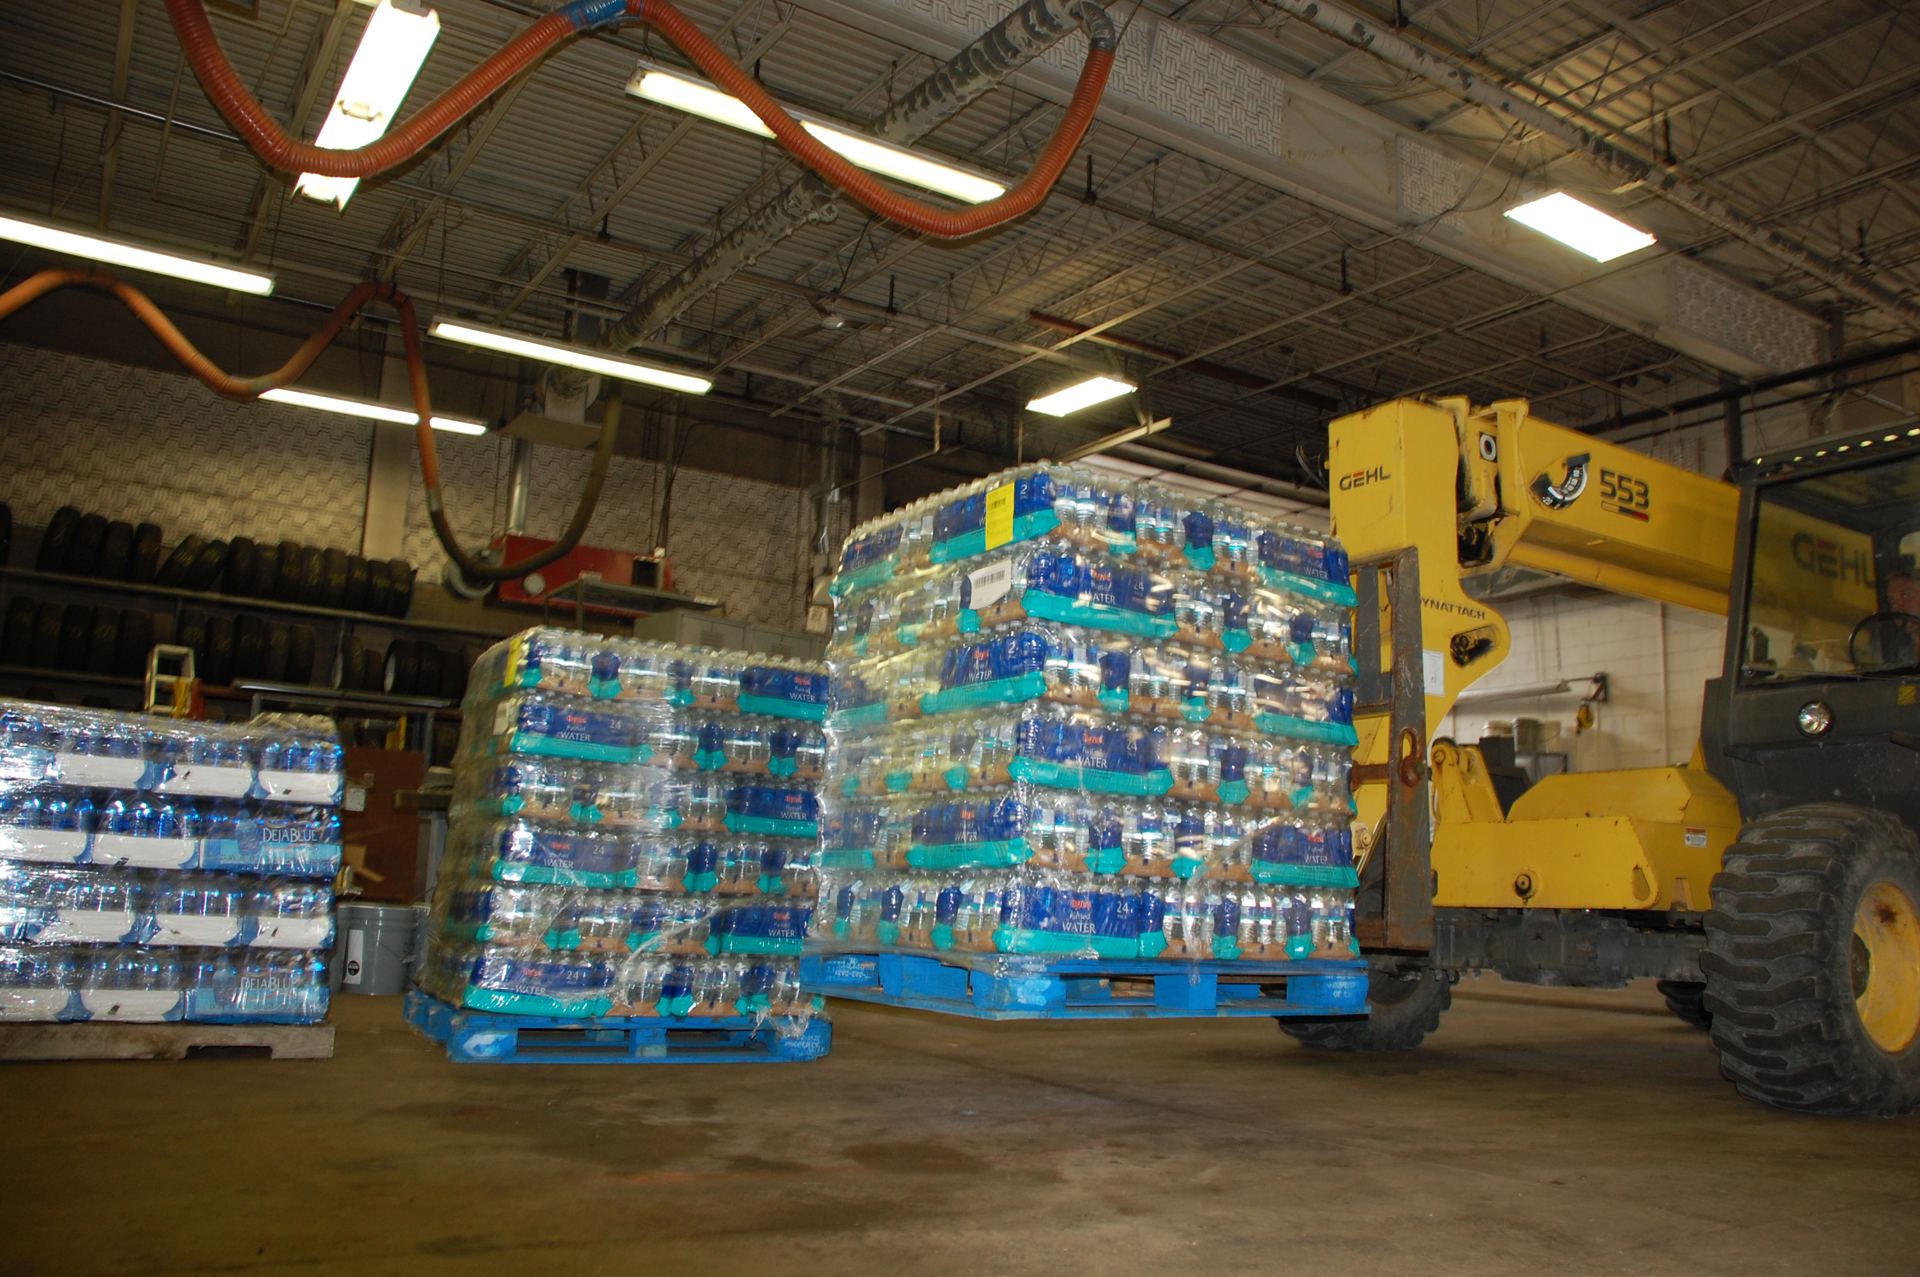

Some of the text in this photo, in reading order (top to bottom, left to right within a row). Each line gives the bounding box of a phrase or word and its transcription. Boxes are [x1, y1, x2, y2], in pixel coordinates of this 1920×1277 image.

[1339, 465, 1391, 491] GEHL
[1600, 468, 1649, 510] 553
[1791, 531, 1876, 589] GEHL
[1085, 590, 1116, 605] ATER
[1420, 598, 1486, 620] YNATTACH
[969, 670, 993, 681] WATER
[789, 692, 816, 703] WATER
[608, 719, 621, 730] 24
[560, 730, 591, 742] WATER
[1075, 752, 1108, 769] WATER
[780, 811, 807, 820] WATER
[593, 845, 605, 856] 24
[544, 858, 574, 869] WATER
[1116, 901, 1129, 914] 24
[768, 928, 796, 938] WATER
[1062, 921, 1096, 934] WATER
[566, 970, 579, 981] 24
[515, 985, 546, 995] WATER
